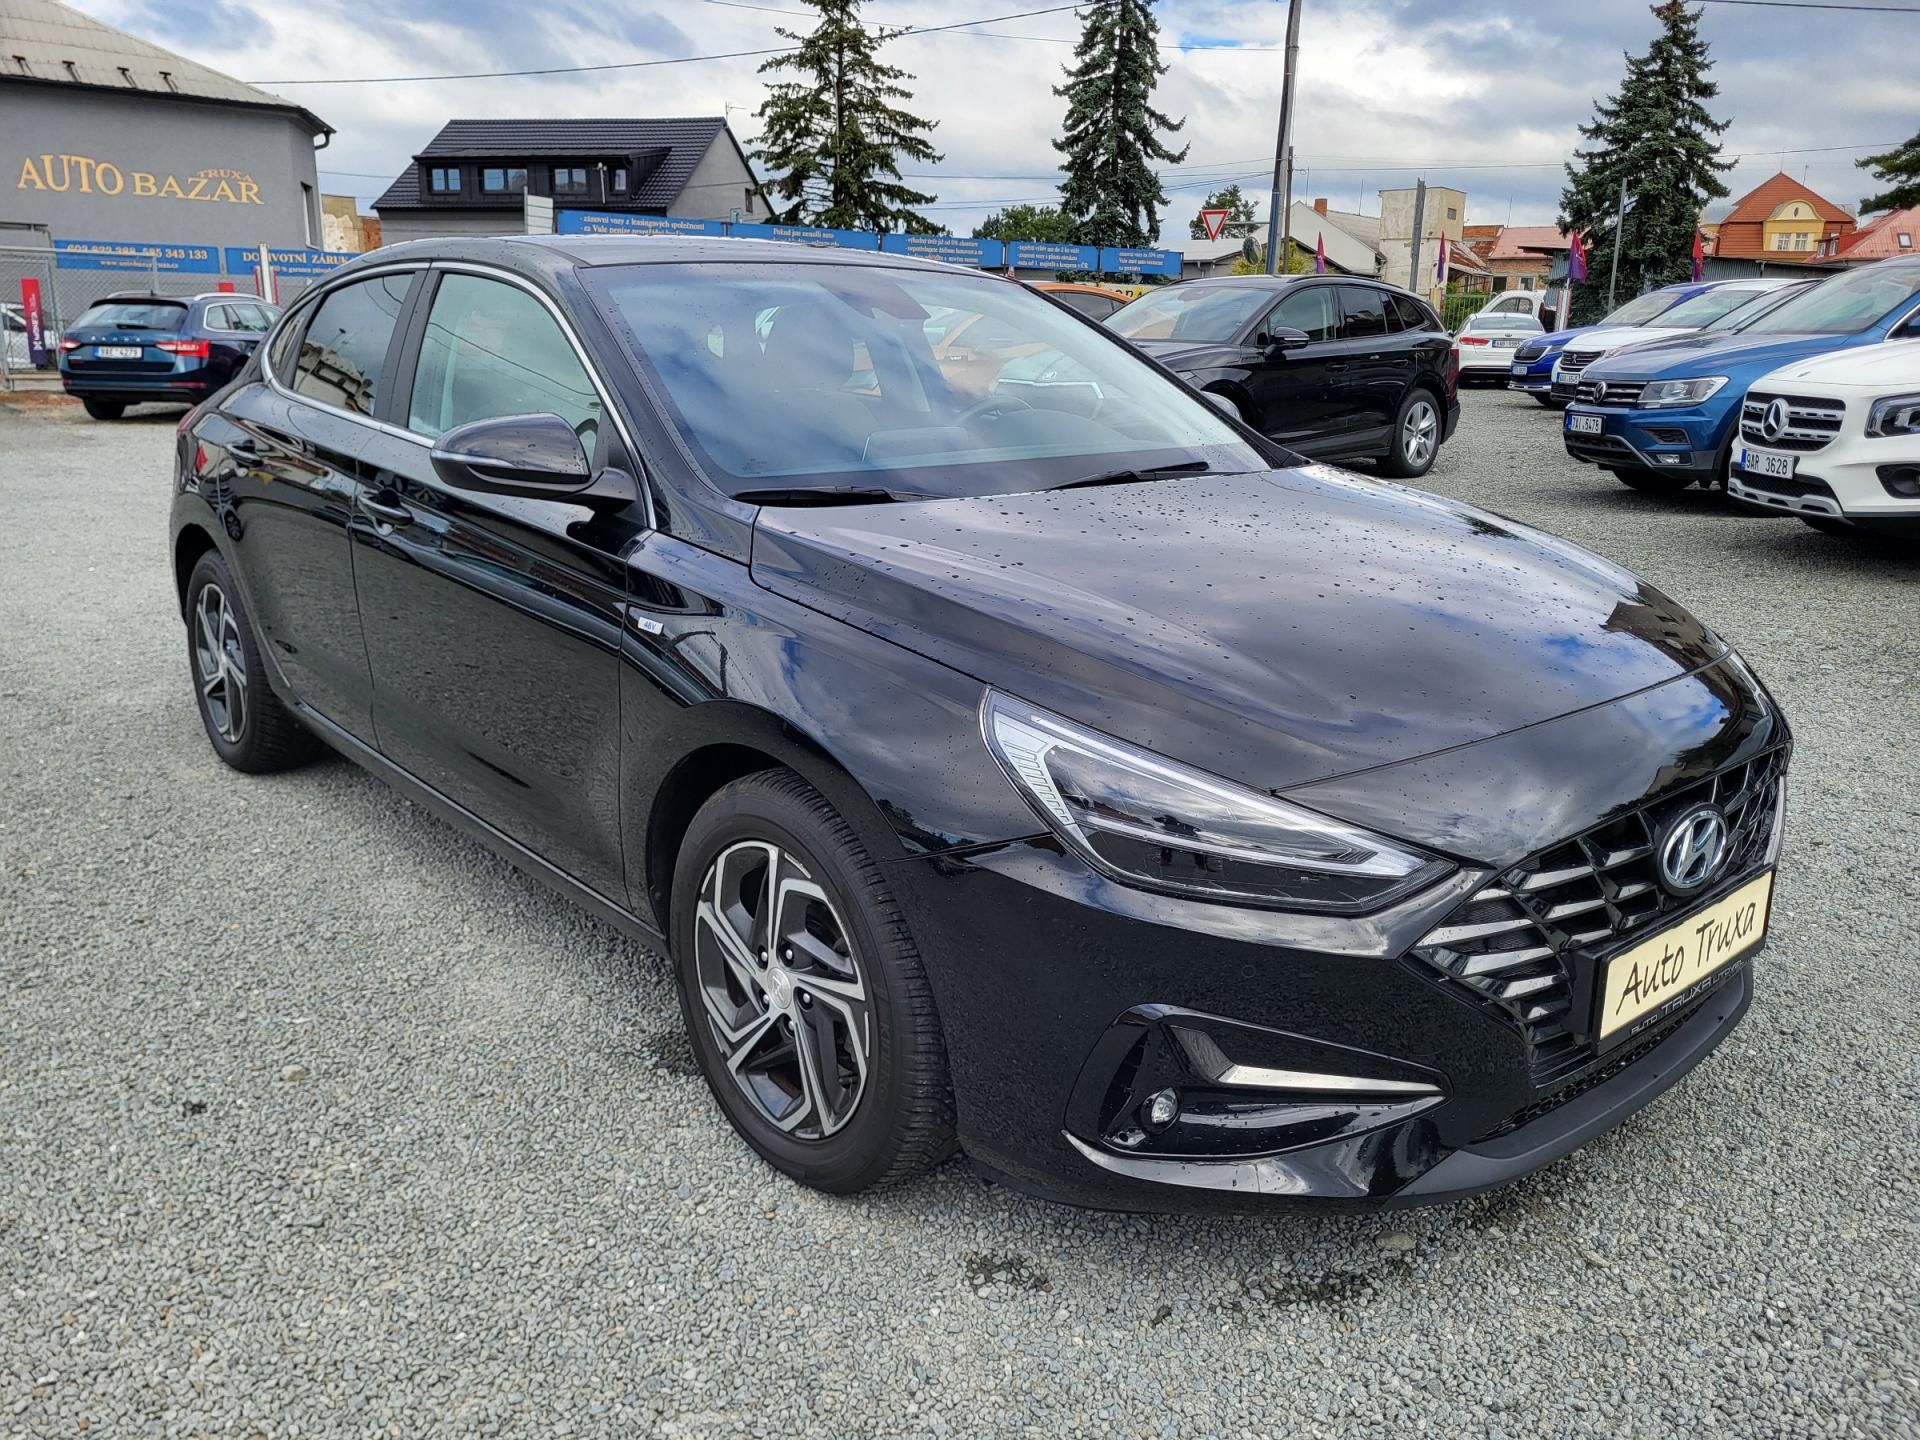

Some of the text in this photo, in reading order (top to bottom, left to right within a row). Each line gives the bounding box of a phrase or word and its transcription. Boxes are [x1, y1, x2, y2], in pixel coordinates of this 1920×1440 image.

[17, 154, 265, 205] AUTO BAZAR
[197, 168, 253, 182] TRUXA
[165, 248, 186, 258] 343
[189, 250, 208, 260] 133
[243, 250, 349, 264] DOIVOTNÍ ZÁRUK
[1746, 454, 1788, 475] 9AR 3628
[644, 620, 656, 630] 48V
[1616, 902, 1756, 1016] Auto Truxa
[1631, 1014, 1658, 1034] AUTO
[1661, 977, 1711, 1015] TRUXA
